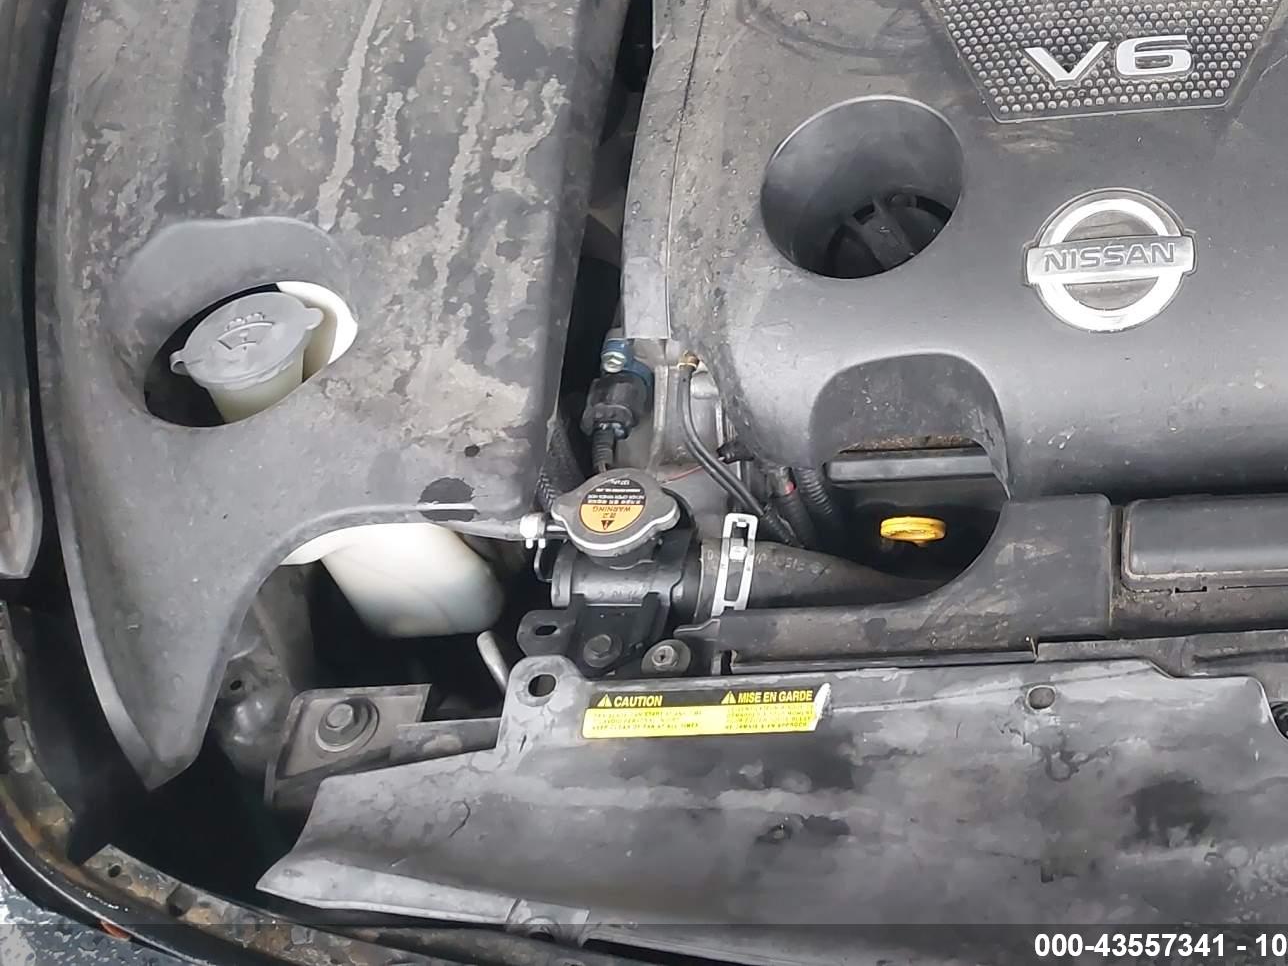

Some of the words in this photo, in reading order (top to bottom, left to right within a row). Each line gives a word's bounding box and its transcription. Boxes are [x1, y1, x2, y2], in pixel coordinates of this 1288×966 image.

[1023, 34, 1193, 83] V6
[1044, 240, 1176, 273] NISSAN
[613, 694, 663, 708] CAUTION
[737, 691, 762, 704] MISE
[763, 691, 778, 703] EN
[778, 690, 814, 702] GARDE
